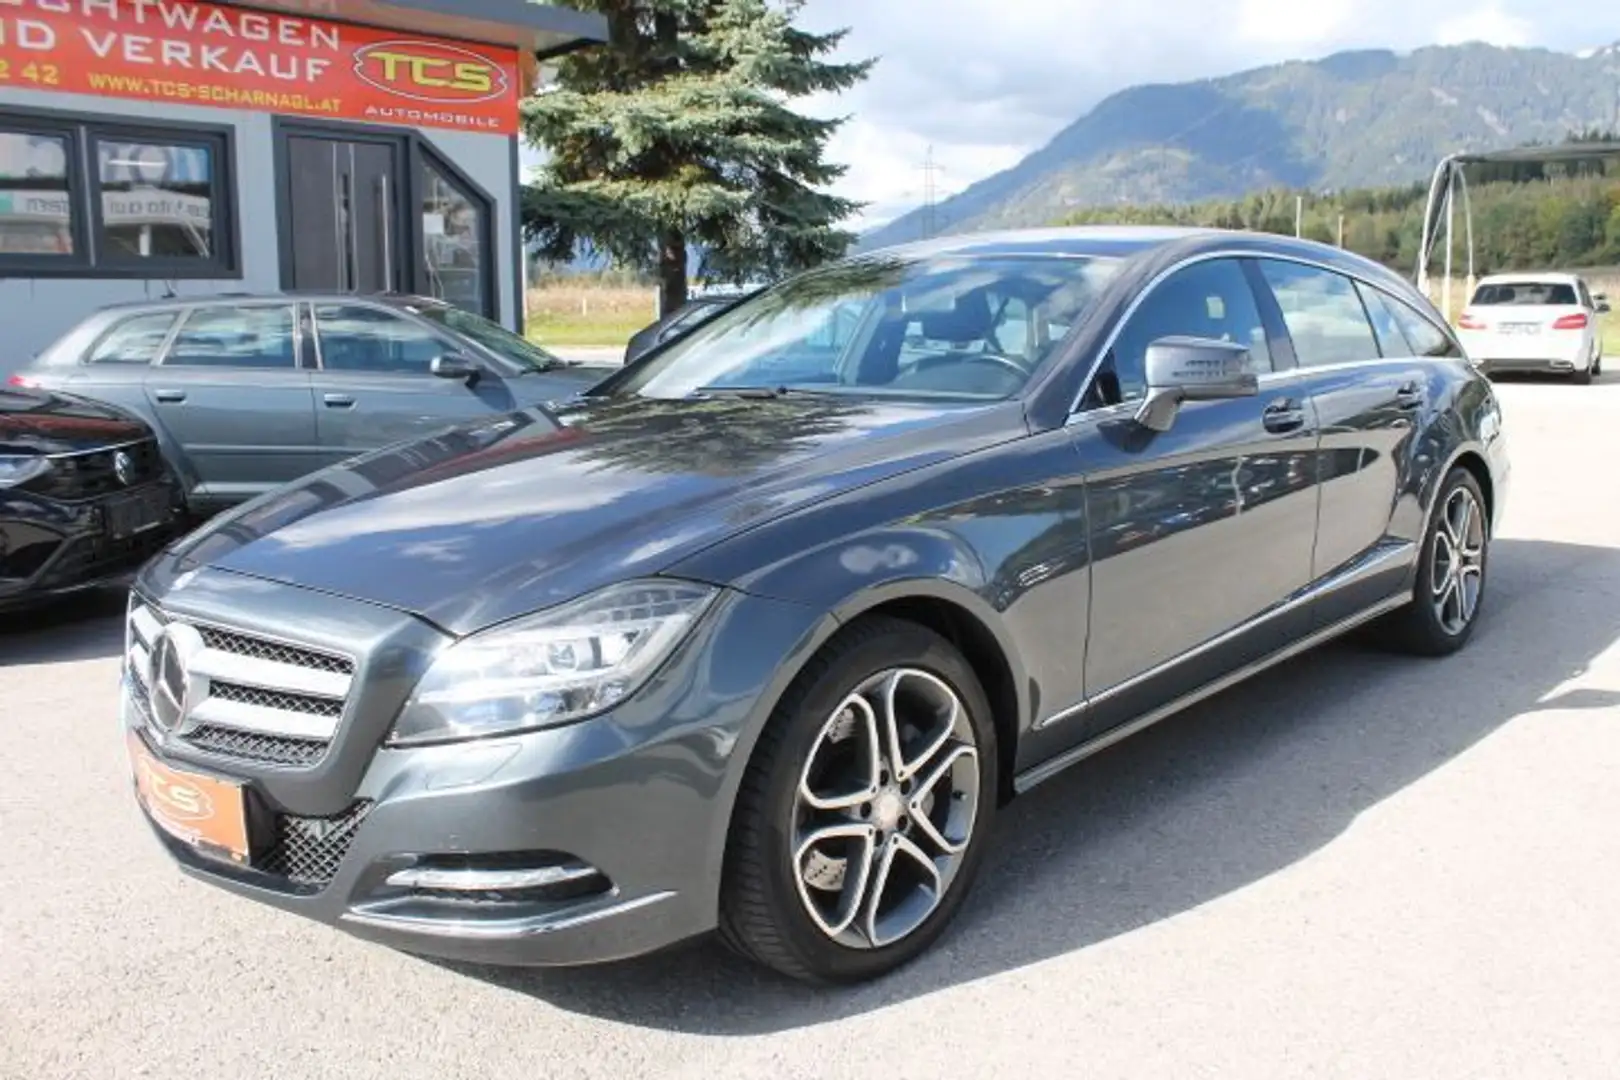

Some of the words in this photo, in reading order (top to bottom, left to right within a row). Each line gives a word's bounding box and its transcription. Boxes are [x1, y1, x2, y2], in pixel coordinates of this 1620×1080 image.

[0, 0, 339, 51] CHTWAGEN
[20, 61, 59, 85] 42
[78, 25, 332, 82] VERKAUF
[367, 52, 493, 92] TCS
[364, 105, 500, 128] AUTOMOBILE
